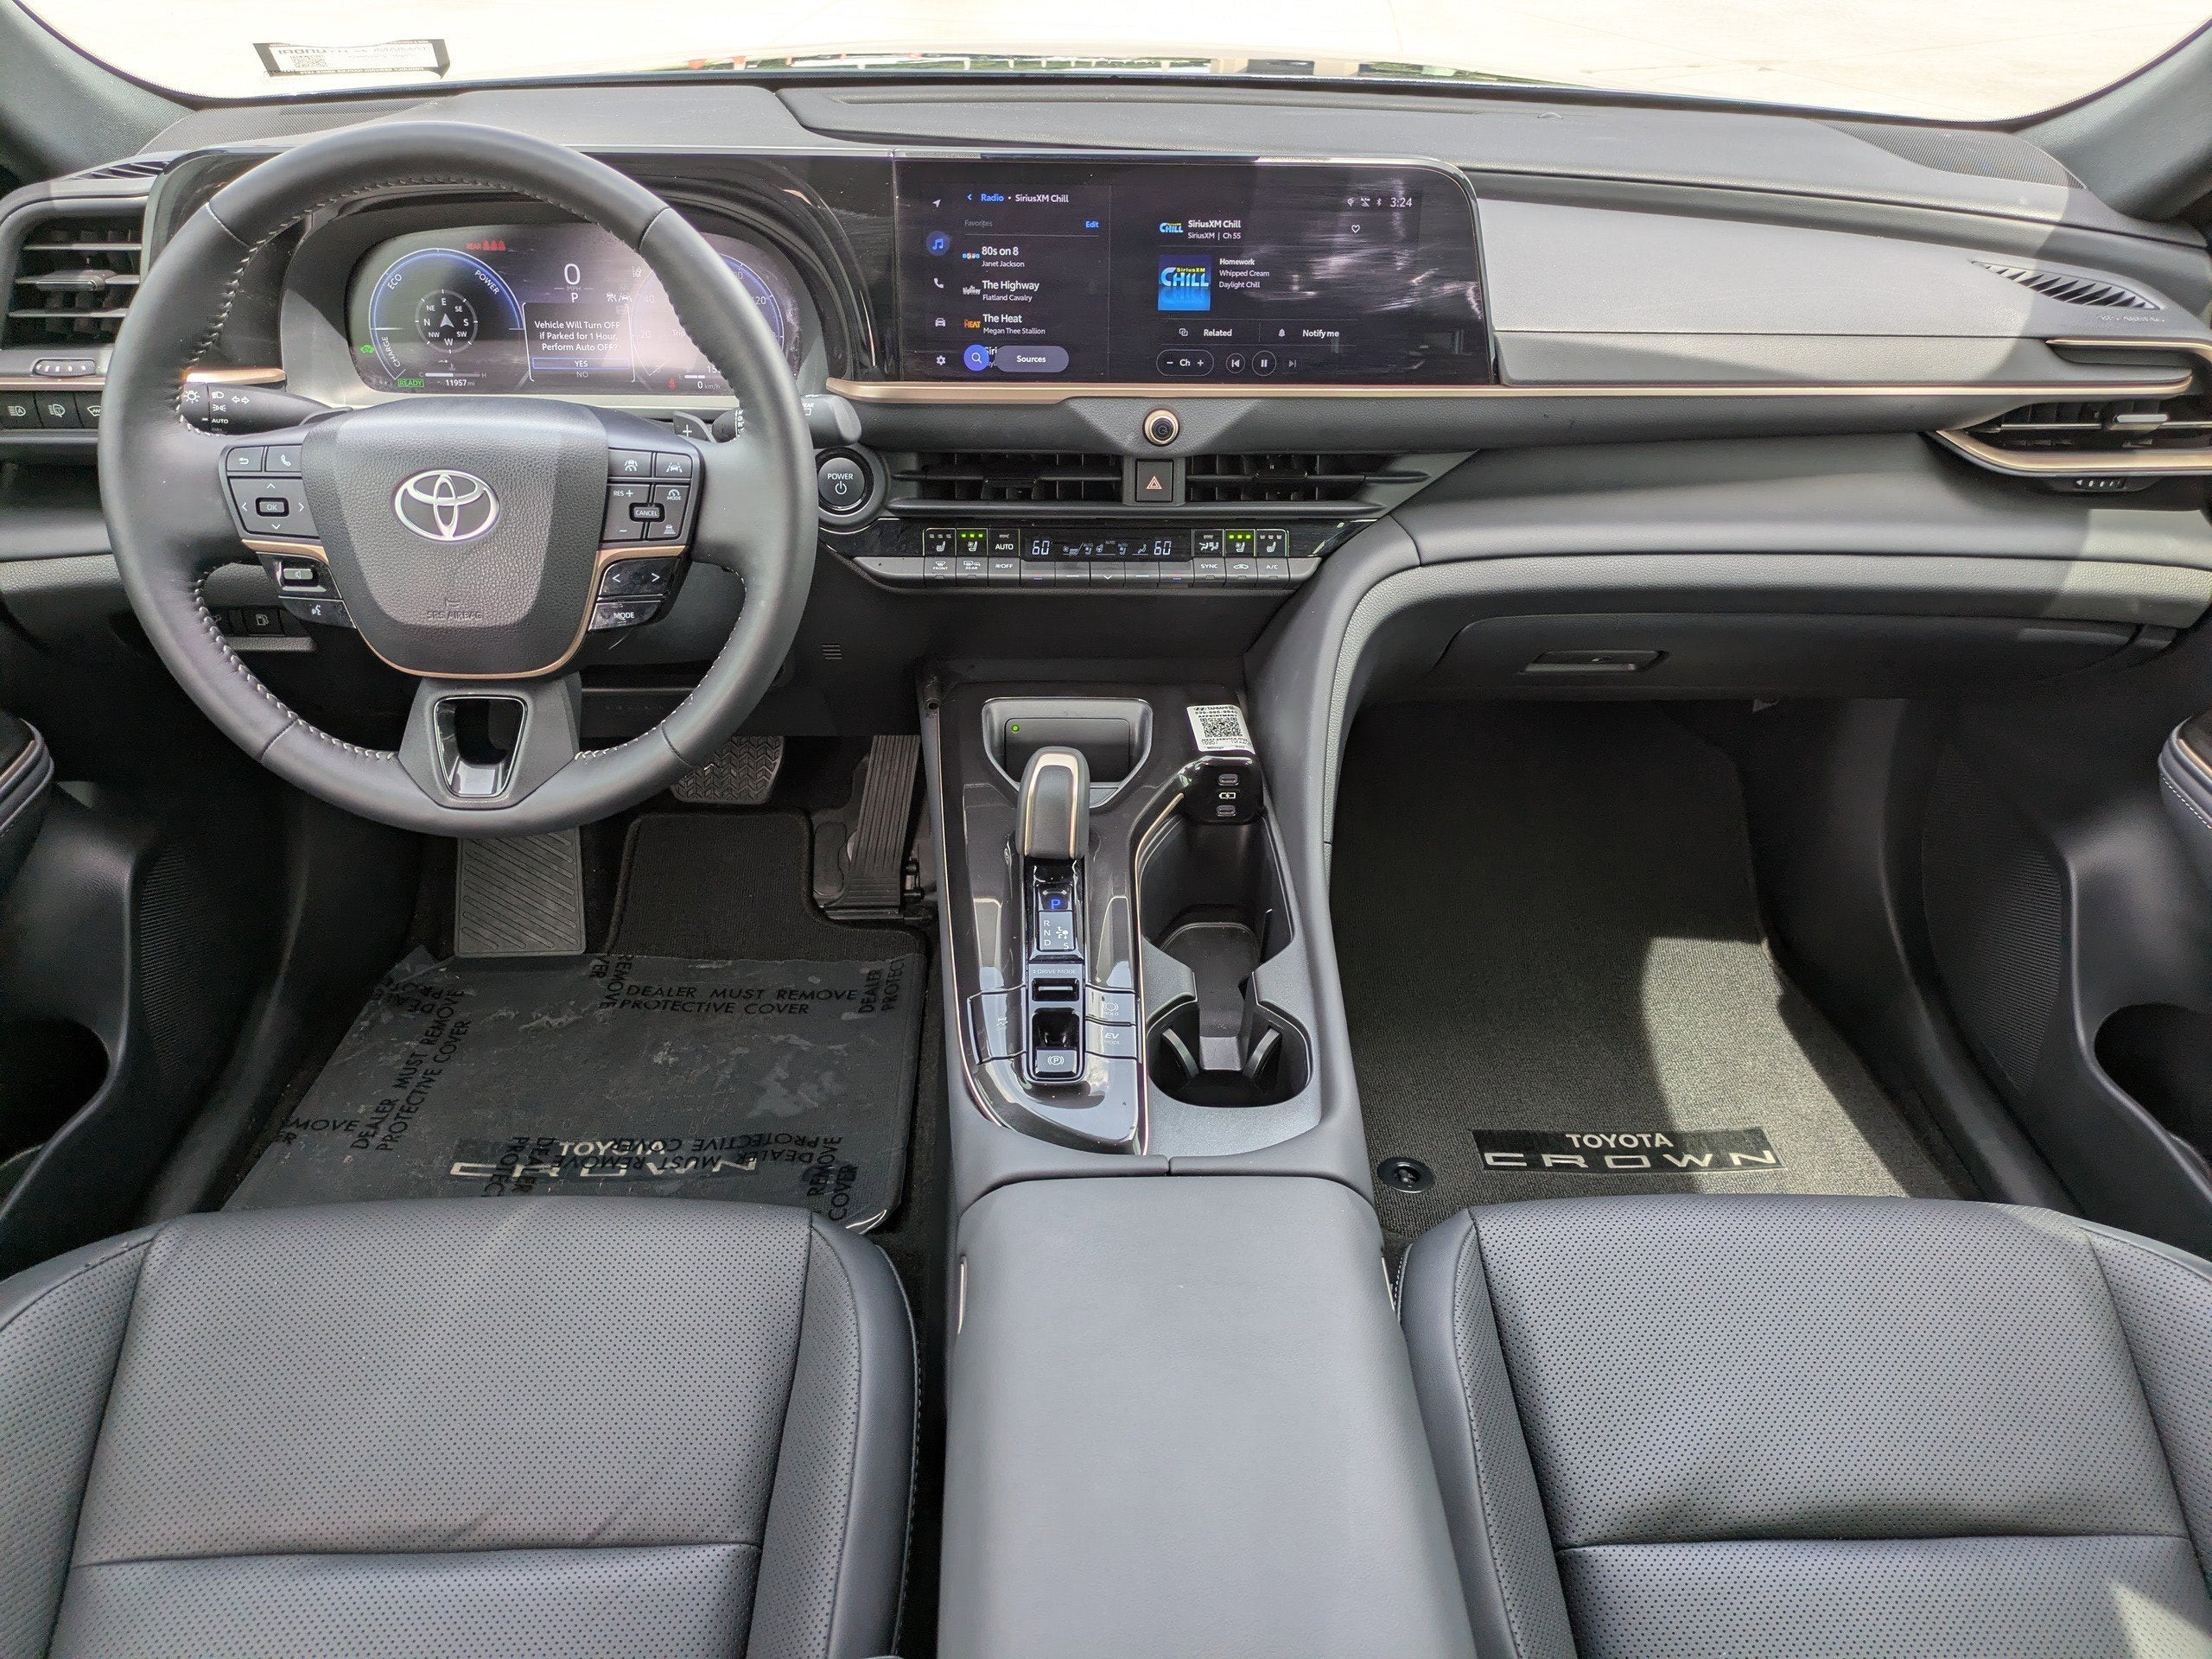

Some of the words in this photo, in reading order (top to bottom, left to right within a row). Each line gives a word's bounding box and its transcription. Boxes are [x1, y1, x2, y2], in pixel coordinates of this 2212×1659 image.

[981, 194, 1004, 203] Radio
[1015, 194, 1049, 203] SiriusXM
[1051, 194, 1069, 203] Chill
[1389, 197, 1413, 208] 3:24
[1085, 220, 1099, 229] Edit
[982, 246, 998, 256] 80s
[1013, 246, 1019, 256] 8
[563, 263, 581, 285] 0
[1160, 266, 1210, 287] CHILL
[387, 273, 403, 290] ECO
[474, 269, 500, 296] POWER
[982, 280, 999, 289] The
[1001, 280, 1039, 292] Highway
[1218, 281, 1245, 289] Daylight
[441, 297, 448, 306] E
[571, 292, 579, 303] P
[1008, 294, 1033, 302] Cavalry
[463, 318, 469, 327] S
[534, 321, 564, 329] Vehicle
[566, 321, 582, 329] Will
[583, 321, 602, 329] Turn
[982, 314, 999, 323] The
[1001, 315, 1022, 323] Heat
[595, 332, 618, 341] Hour,
[1203, 328, 1232, 338] Related
[1302, 328, 1326, 339] Notify
[381, 335, 401, 368] CHARGE
[1016, 355, 1046, 364] Sources
[1179, 358, 1191, 366] Ch
[1032, 540, 1051, 556] 60
[1154, 541, 1172, 556] 60
[1051, 899, 1060, 909] P
[599, 954, 632, 1008] REMOVE
[626, 984, 696, 997] DEALER
[709, 988, 766, 1000] MUST
[776, 988, 860, 1001] REMOVE
[858, 969, 883, 1013] DEALER
[619, 999, 735, 1014] PROTECTIVE
[744, 1002, 809, 1014] COVER
[349, 1097, 399, 1151] DEALER
[394, 1051, 429, 1090] MUST
[419, 989, 467, 1047] REMOVE
[375, 1067, 443, 1152] PROTECTIVE
[434, 1019, 473, 1065] COVER
[693, 1133, 818, 1152] PROTECTIVE
[1565, 1133, 1675, 1148] TOYOTA
[559, 1141, 664, 1156] TOYOTA
[658, 1154, 721, 1170] MUST
[1484, 1150, 1778, 1167] CROWN
